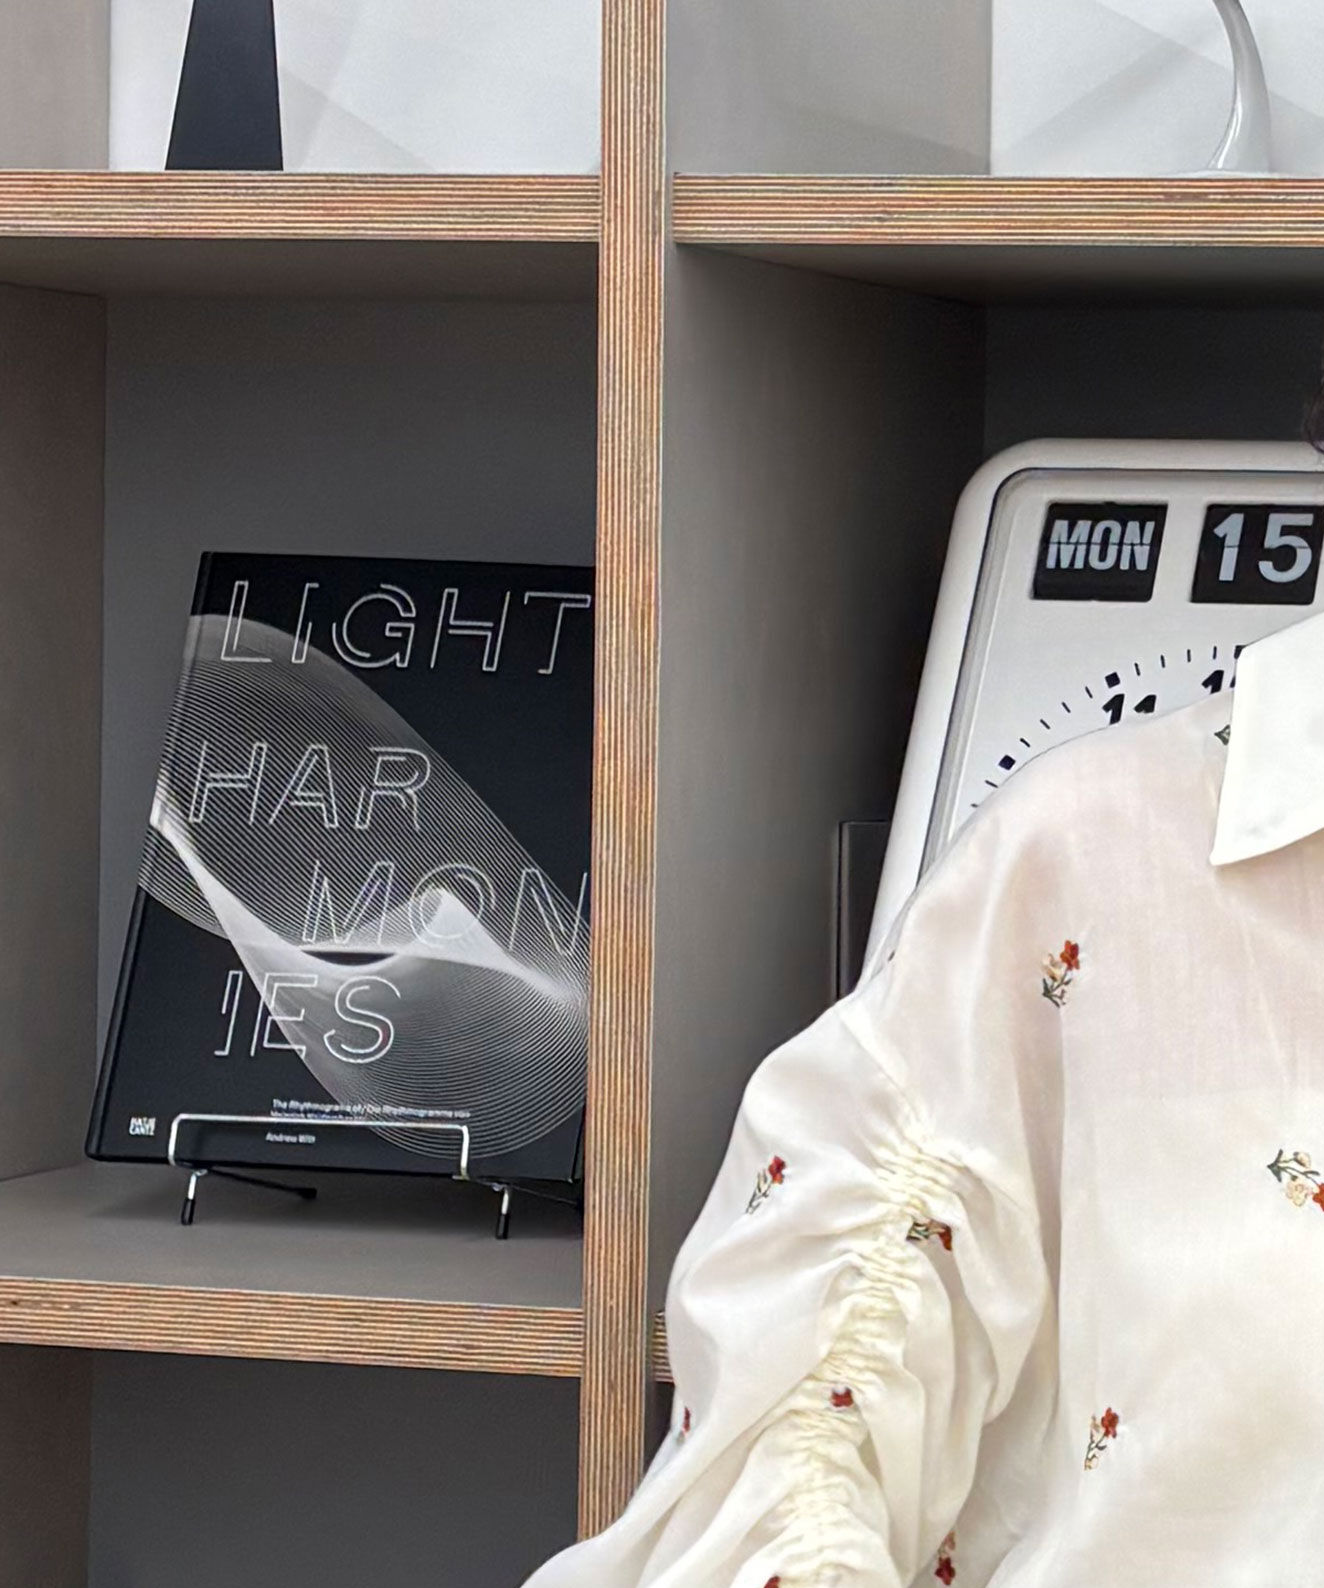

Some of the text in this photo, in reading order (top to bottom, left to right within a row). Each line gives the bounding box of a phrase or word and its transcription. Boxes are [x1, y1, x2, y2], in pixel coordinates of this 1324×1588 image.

[1045, 519, 1155, 571] MON
[1213, 513, 1314, 582] 15
[220, 580, 592, 675] LIGHT
[188, 743, 431, 832] HAR
[301, 859, 589, 956] MON
[214, 969, 401, 1065] IES
